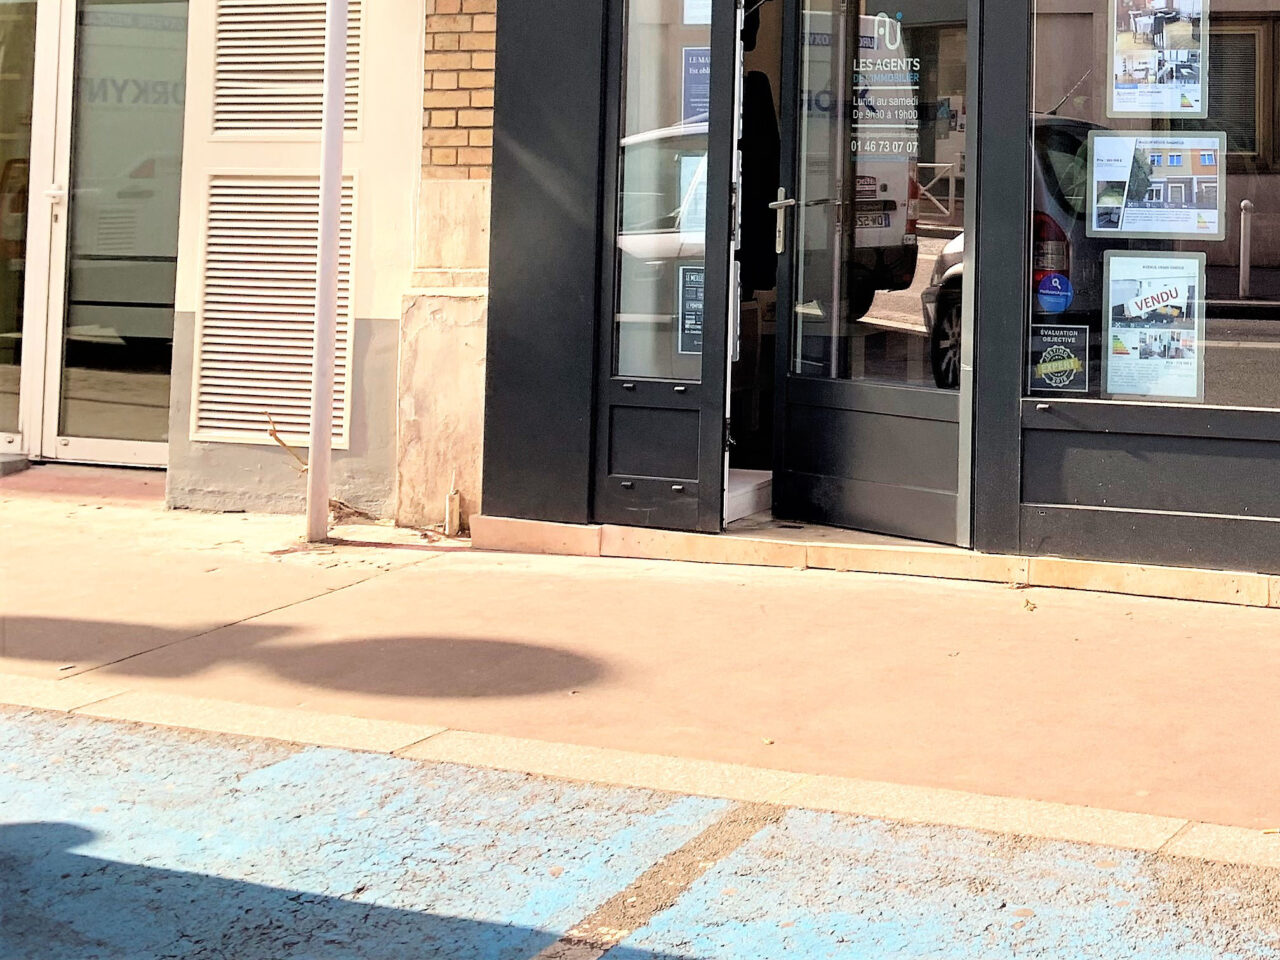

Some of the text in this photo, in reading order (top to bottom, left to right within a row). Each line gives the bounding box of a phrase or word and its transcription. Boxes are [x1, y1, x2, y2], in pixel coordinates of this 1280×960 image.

[853, 57, 920, 71] LES AGENTS
[853, 73, 864, 83] DE
[852, 95, 919, 106] Lundi au samedi
[852, 109, 864, 119] De
[865, 109, 885, 119] 9h30
[894, 109, 918, 119] 19h00
[851, 140, 919, 153] 01 46 73 07 07
[1134, 286, 1179, 311] VENDU
[1040, 327, 1078, 337] ÉVALUATION
[1041, 358, 1075, 373] EXPERT
